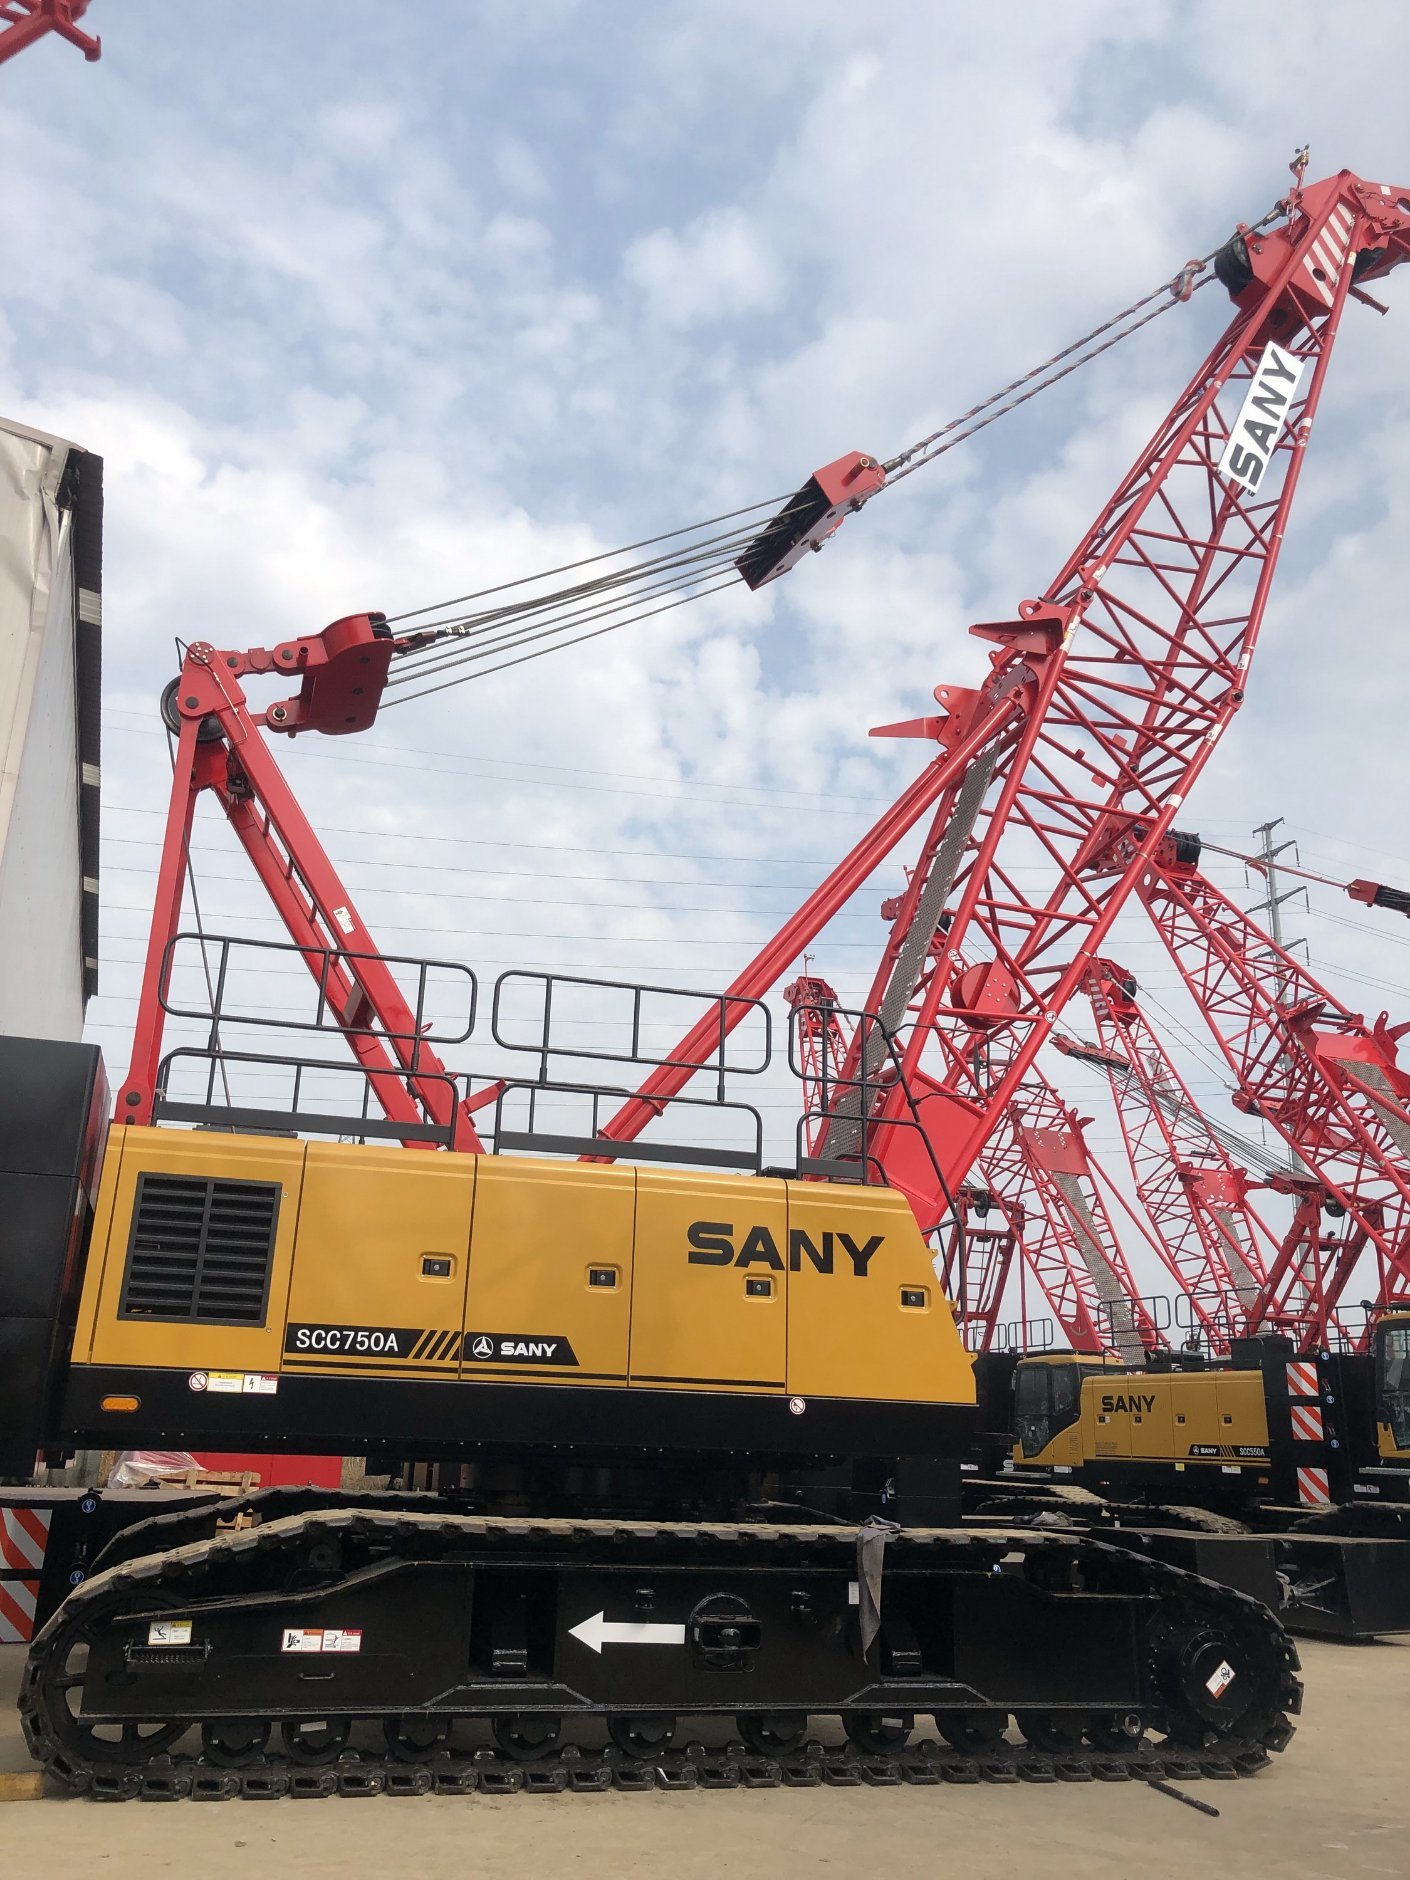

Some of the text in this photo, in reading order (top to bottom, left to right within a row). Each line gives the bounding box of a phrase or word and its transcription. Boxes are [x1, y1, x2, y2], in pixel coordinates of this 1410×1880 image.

[1229, 348, 1298, 486] SANY
[687, 1221, 885, 1277] SANY
[296, 1329, 399, 1352] SCC750A
[500, 1341, 557, 1357] SANY
[1101, 1395, 1156, 1413] SANY
[1200, 1447, 1217, 1455] SANY
[1239, 1447, 1265, 1457] SCC550A
